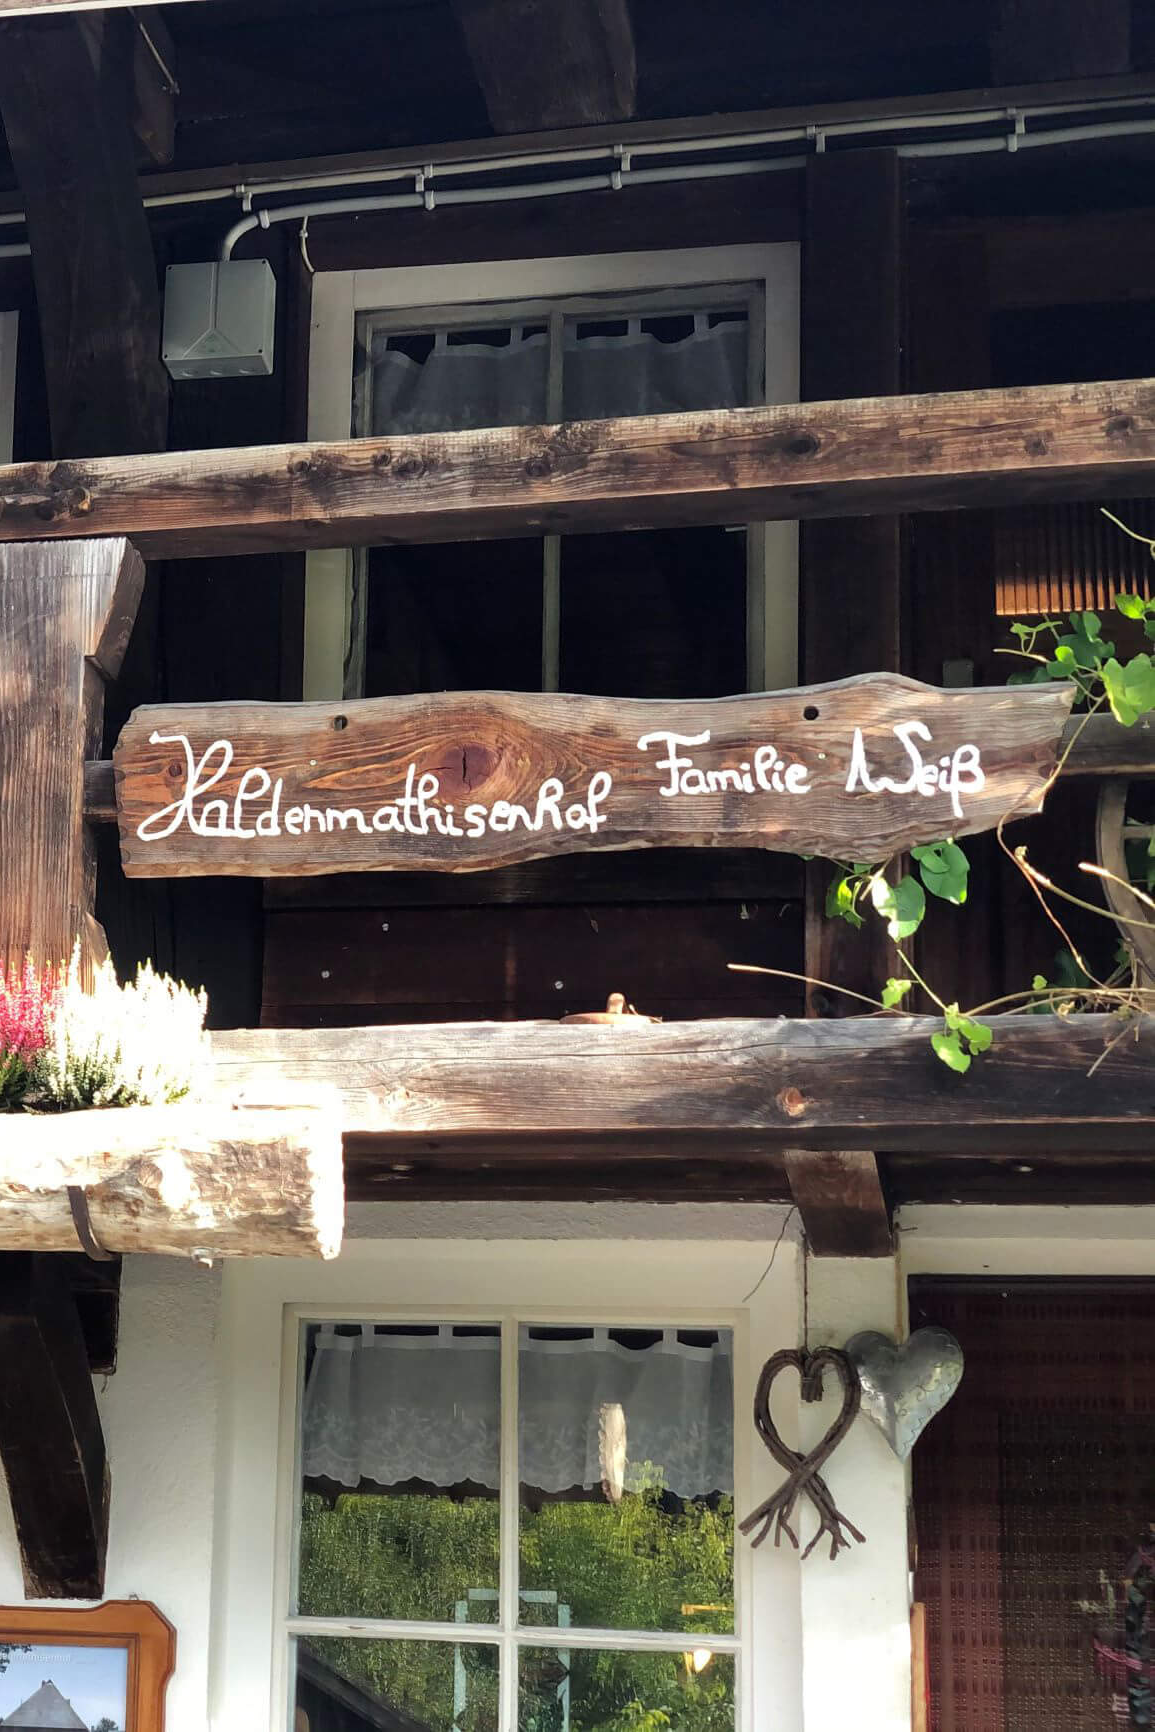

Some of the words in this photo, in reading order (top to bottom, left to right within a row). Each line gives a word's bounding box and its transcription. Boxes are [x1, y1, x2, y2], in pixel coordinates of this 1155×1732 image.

[136, 730, 613, 842] Haldenmathisenhof
[637, 730, 811, 797] Familie
[845, 721, 986, 819] Weiß
